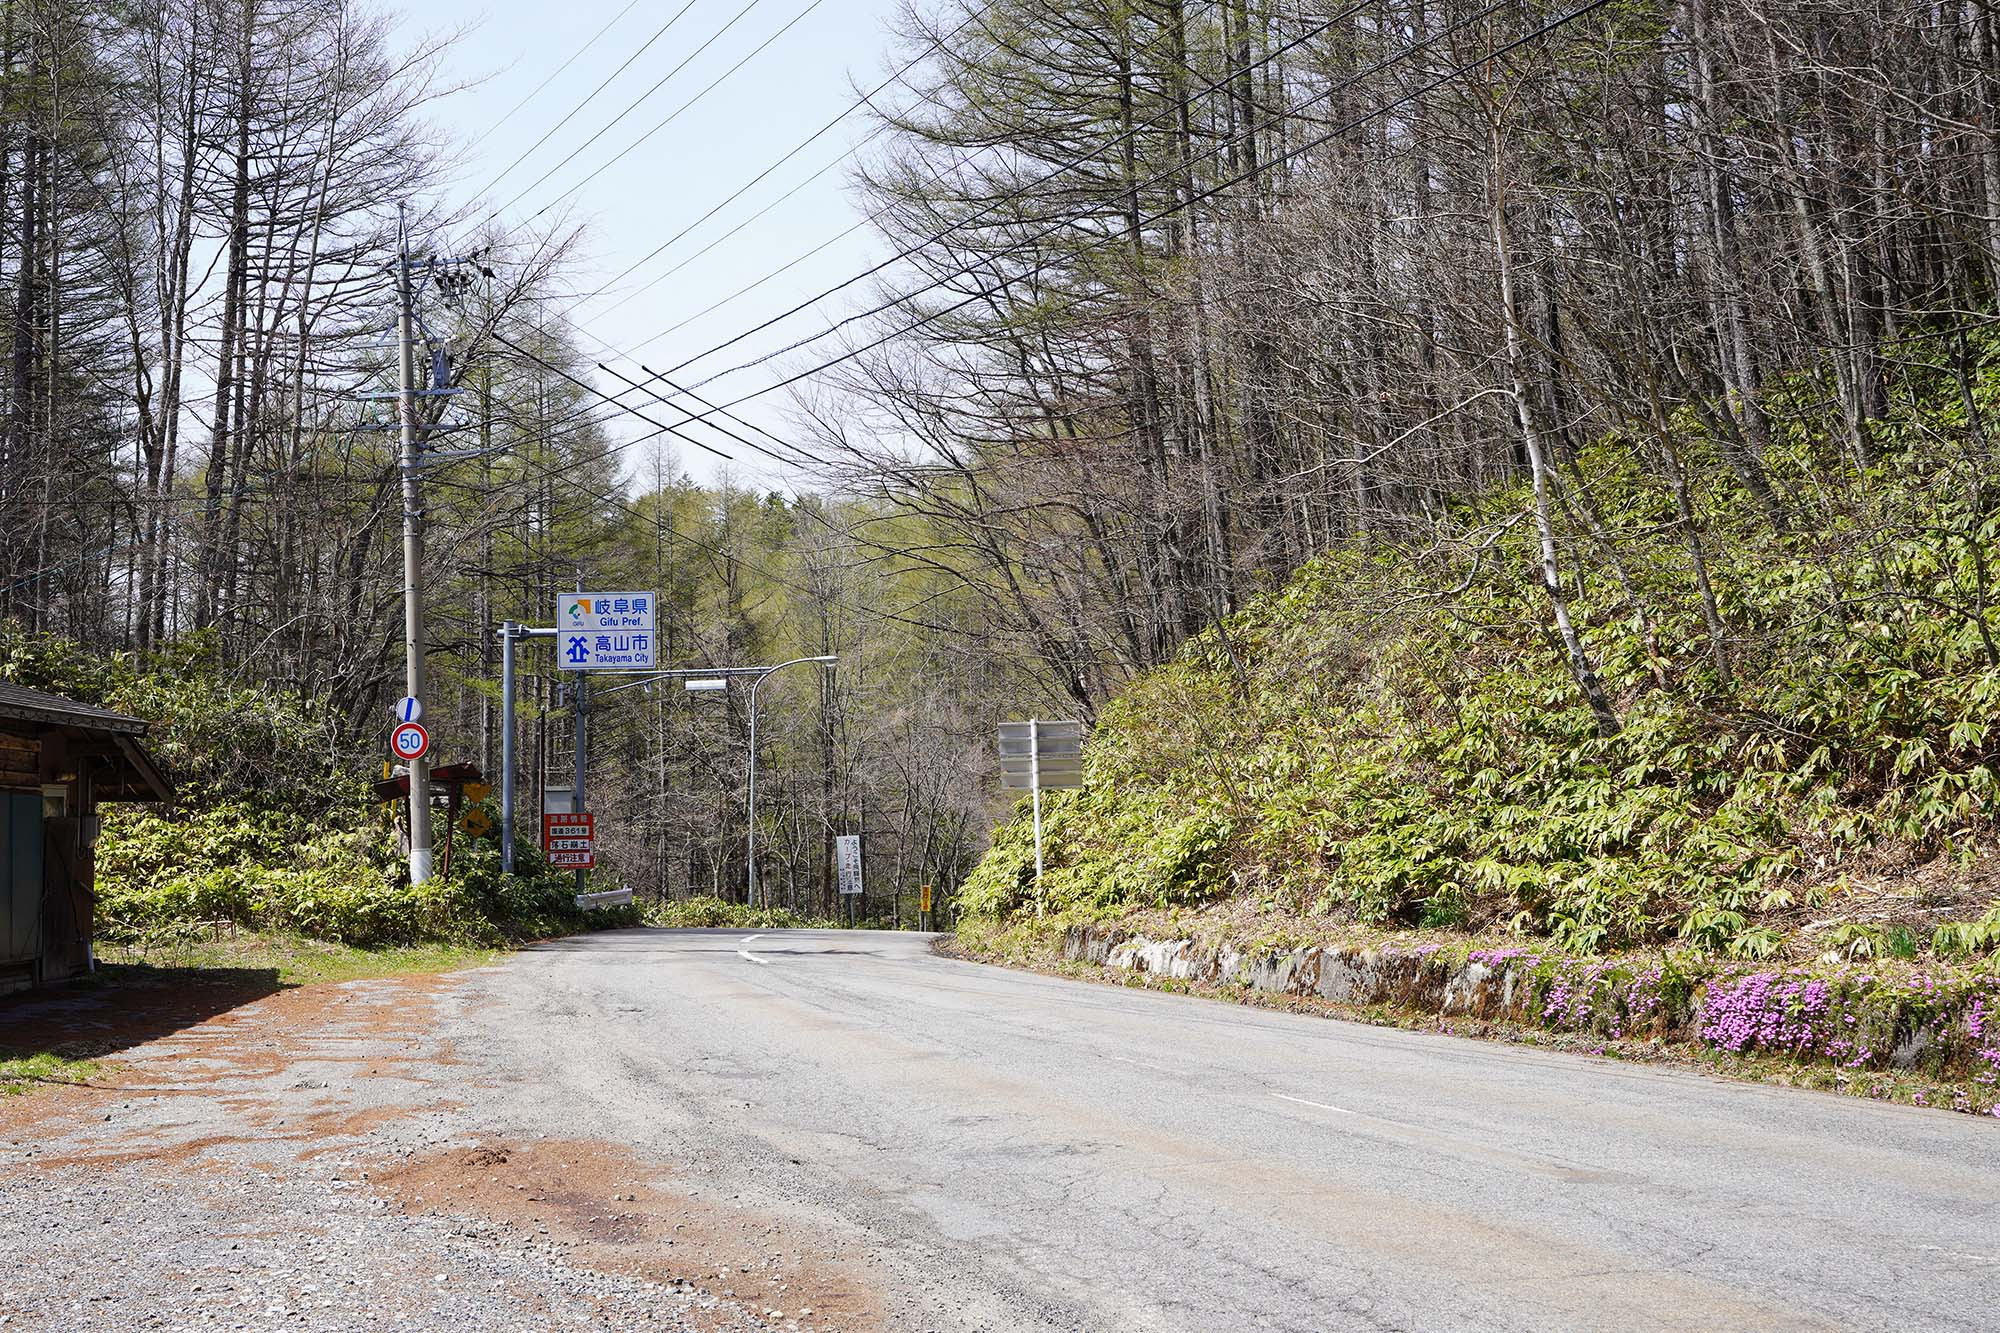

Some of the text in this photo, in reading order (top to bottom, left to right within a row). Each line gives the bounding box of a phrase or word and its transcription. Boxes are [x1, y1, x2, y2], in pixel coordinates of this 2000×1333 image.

[595, 598, 647, 615] 岐阜県
[600, 617, 643, 626] Gifu Pref.
[595, 634, 648, 652] 高山市
[595, 653, 648, 664] Takayama City
[400, 733, 420, 749] 50
